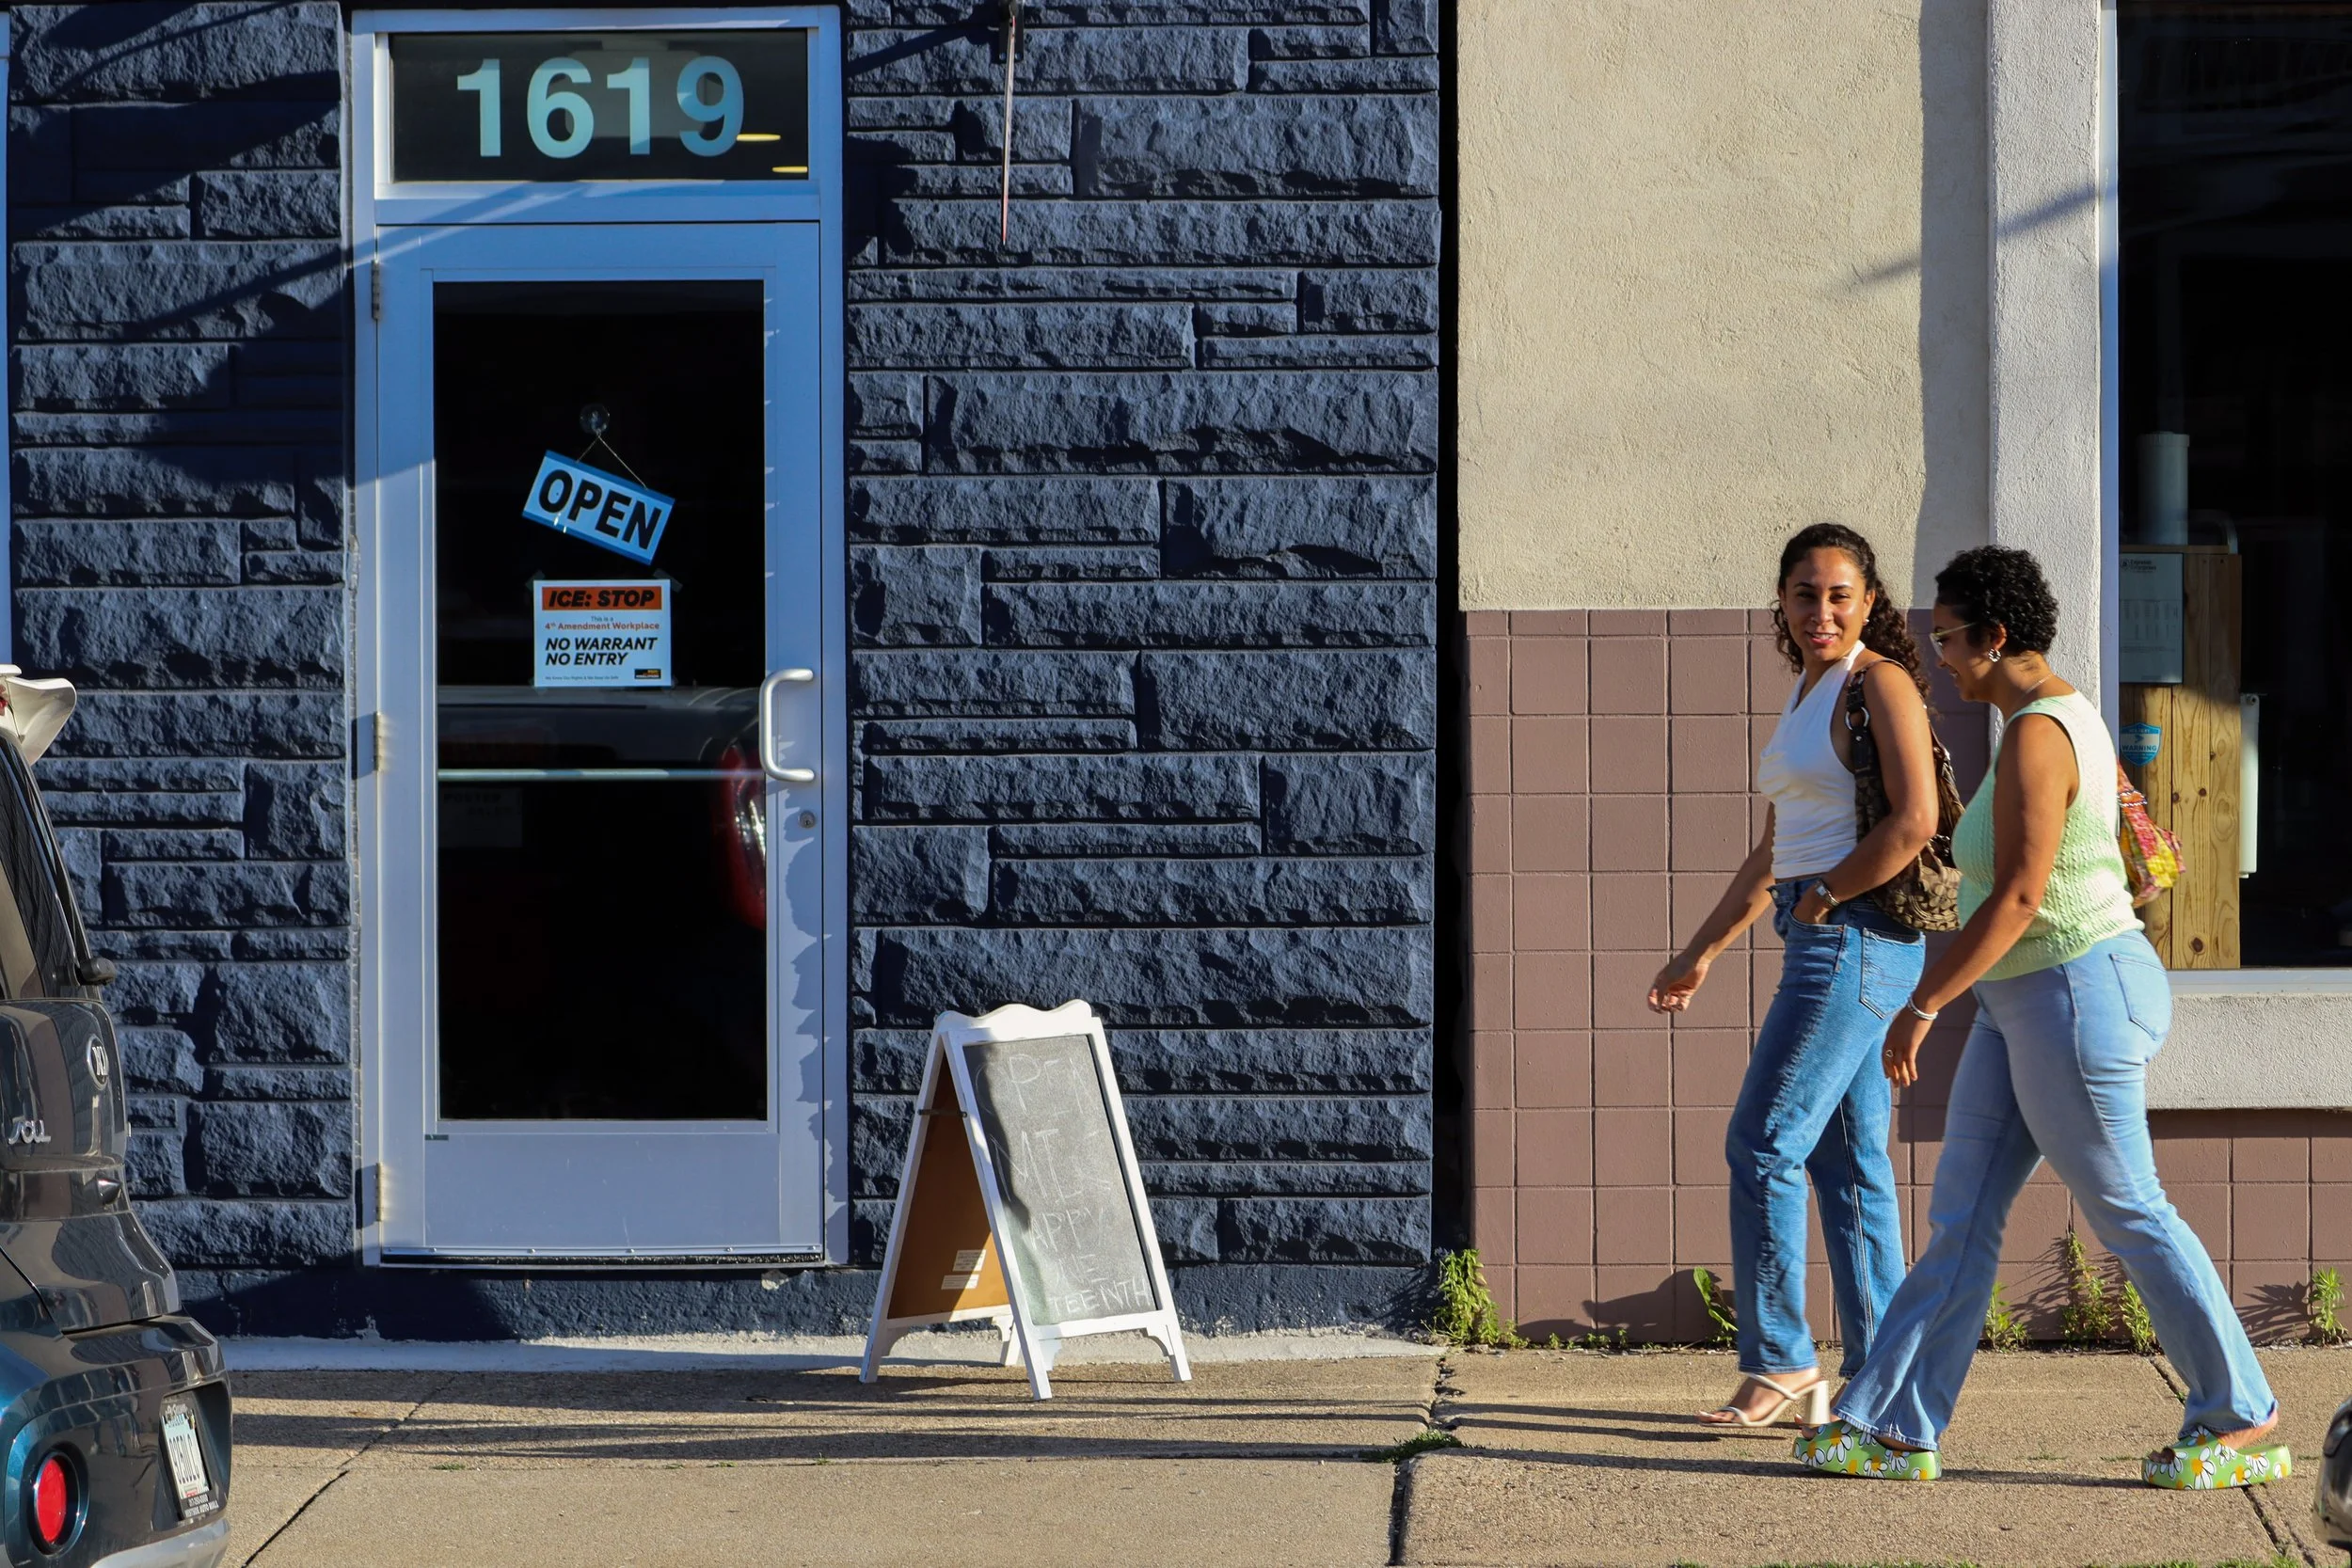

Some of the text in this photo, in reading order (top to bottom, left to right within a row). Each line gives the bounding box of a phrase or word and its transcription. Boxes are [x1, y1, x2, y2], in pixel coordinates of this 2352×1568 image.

[457, 55, 744, 159] 1619
[538, 468, 661, 550] OPEN
[548, 590, 655, 608] ICE: STOP
[545, 621, 556, 630] 4th
[612, 622, 660, 631] Workplace
[545, 637, 659, 650] NO WARRANT
[545, 652, 628, 666] NO ENTRY
[976, 1053, 1100, 1118] OPEN
[1048, 1275, 1151, 1317] TEENTH
